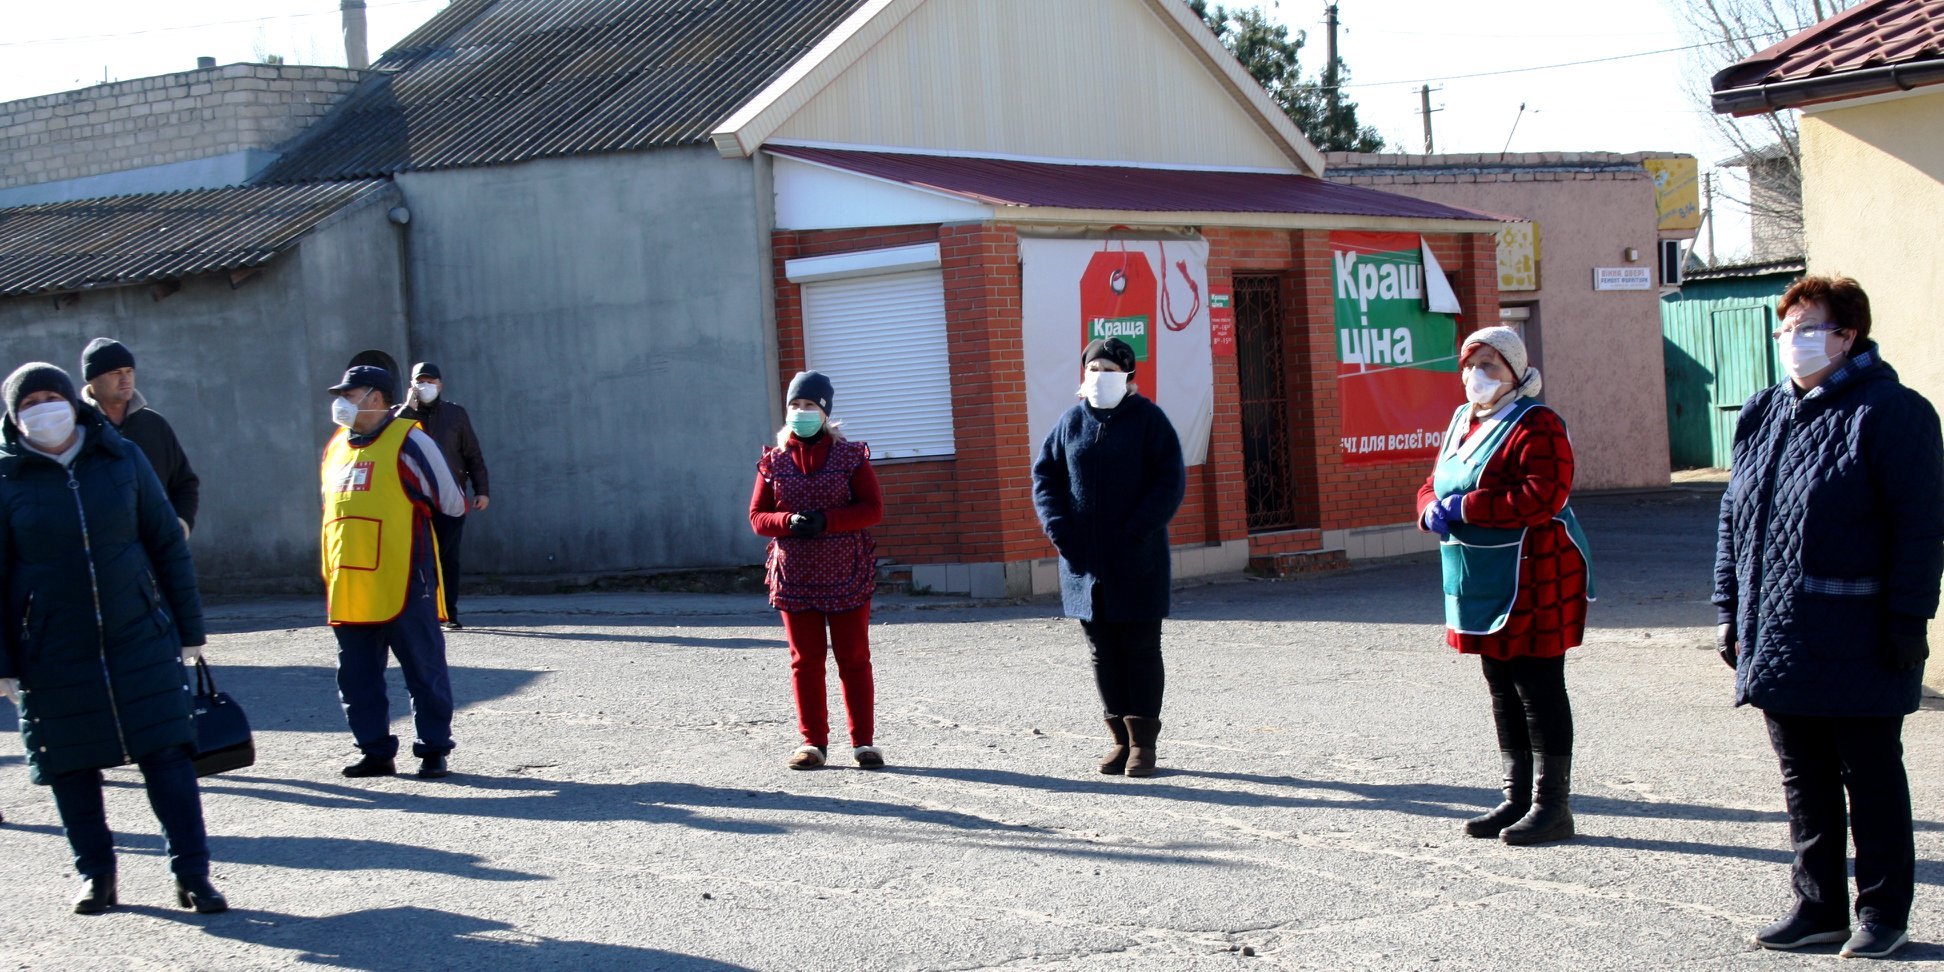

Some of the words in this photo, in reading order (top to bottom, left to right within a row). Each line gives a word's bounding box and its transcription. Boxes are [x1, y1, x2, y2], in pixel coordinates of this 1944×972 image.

[1094, 317, 1145, 340] Краща
[1340, 315, 1413, 373] ціна
[1340, 437, 1357, 453] ЧІ
[1359, 435, 1385, 454] ДЛЯ
[1388, 428, 1423, 450] ВСІЄЇ
